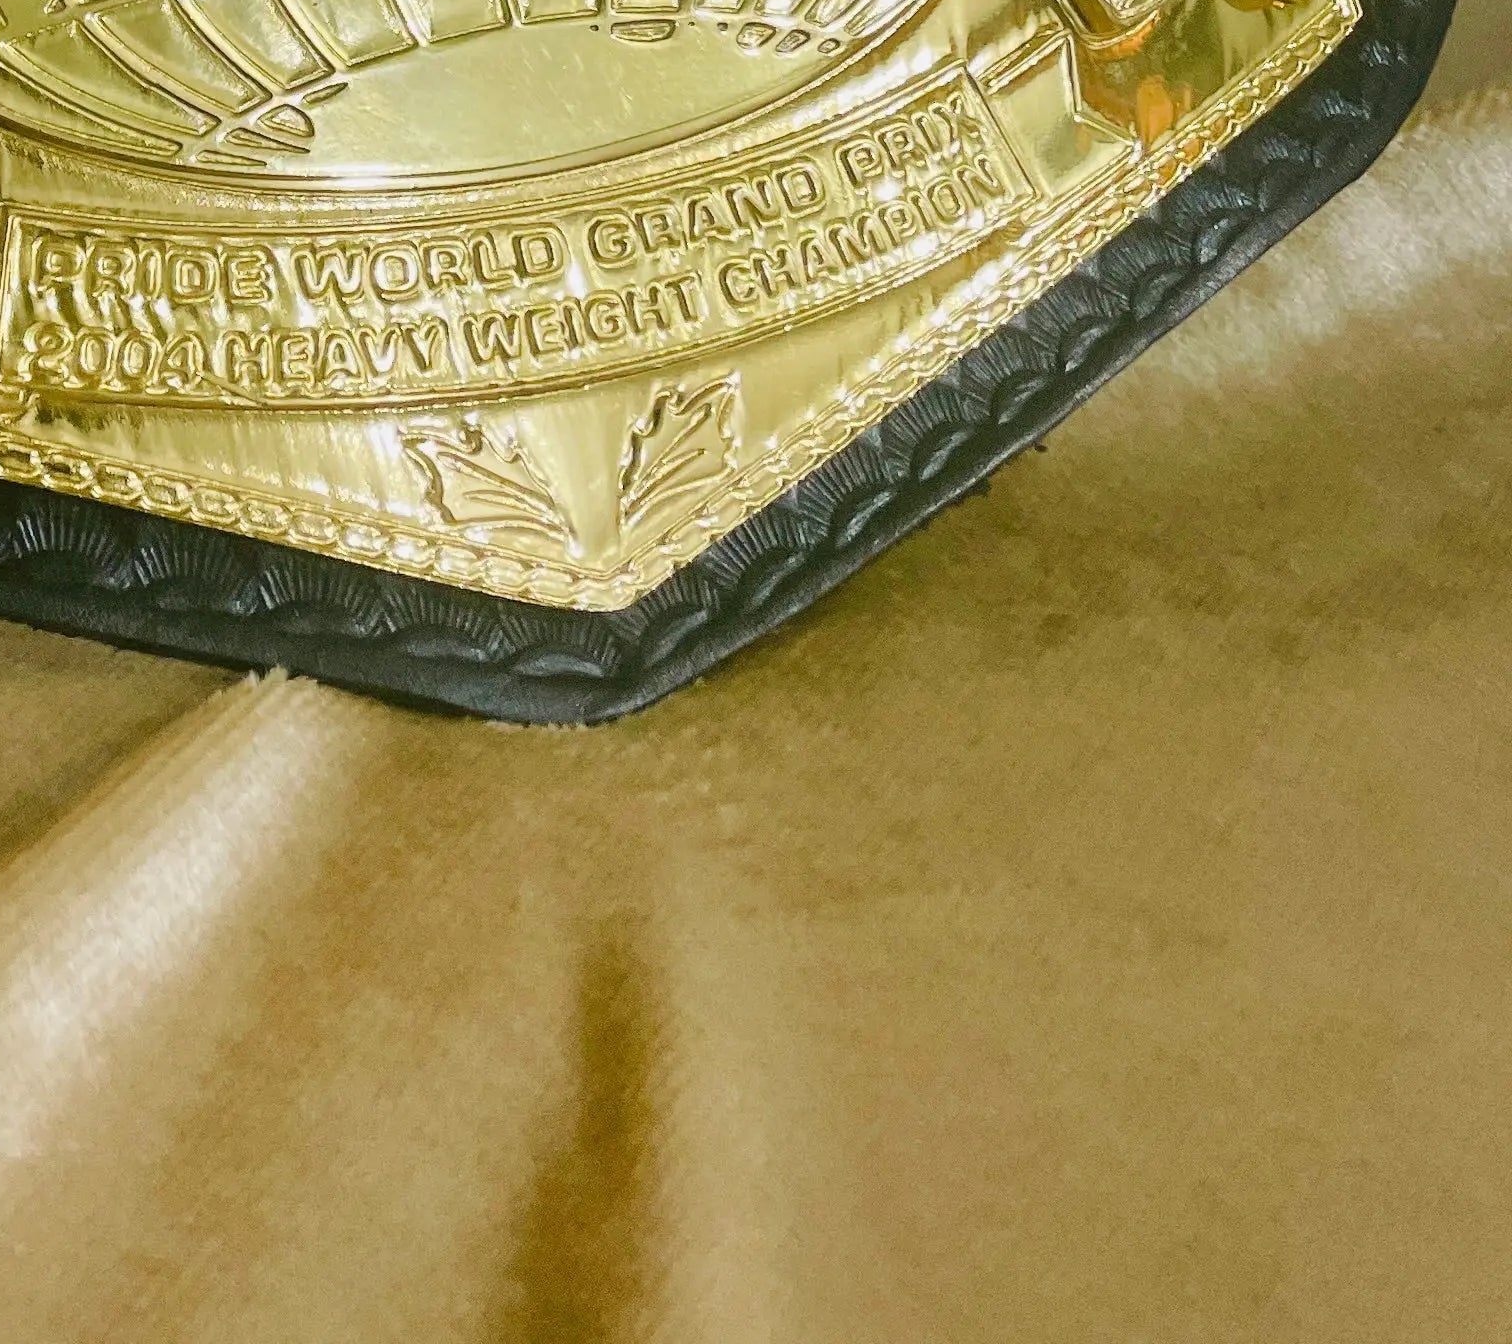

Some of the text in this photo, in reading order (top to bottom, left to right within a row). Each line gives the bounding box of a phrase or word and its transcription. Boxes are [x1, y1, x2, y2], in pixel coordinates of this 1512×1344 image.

[26, 92, 988, 306] PRIDE WORLD GRAND PRIX
[219, 315, 451, 393] HEAVY
[459, 272, 704, 368] WEIGHT
[716, 152, 1006, 313] CHAMPION
